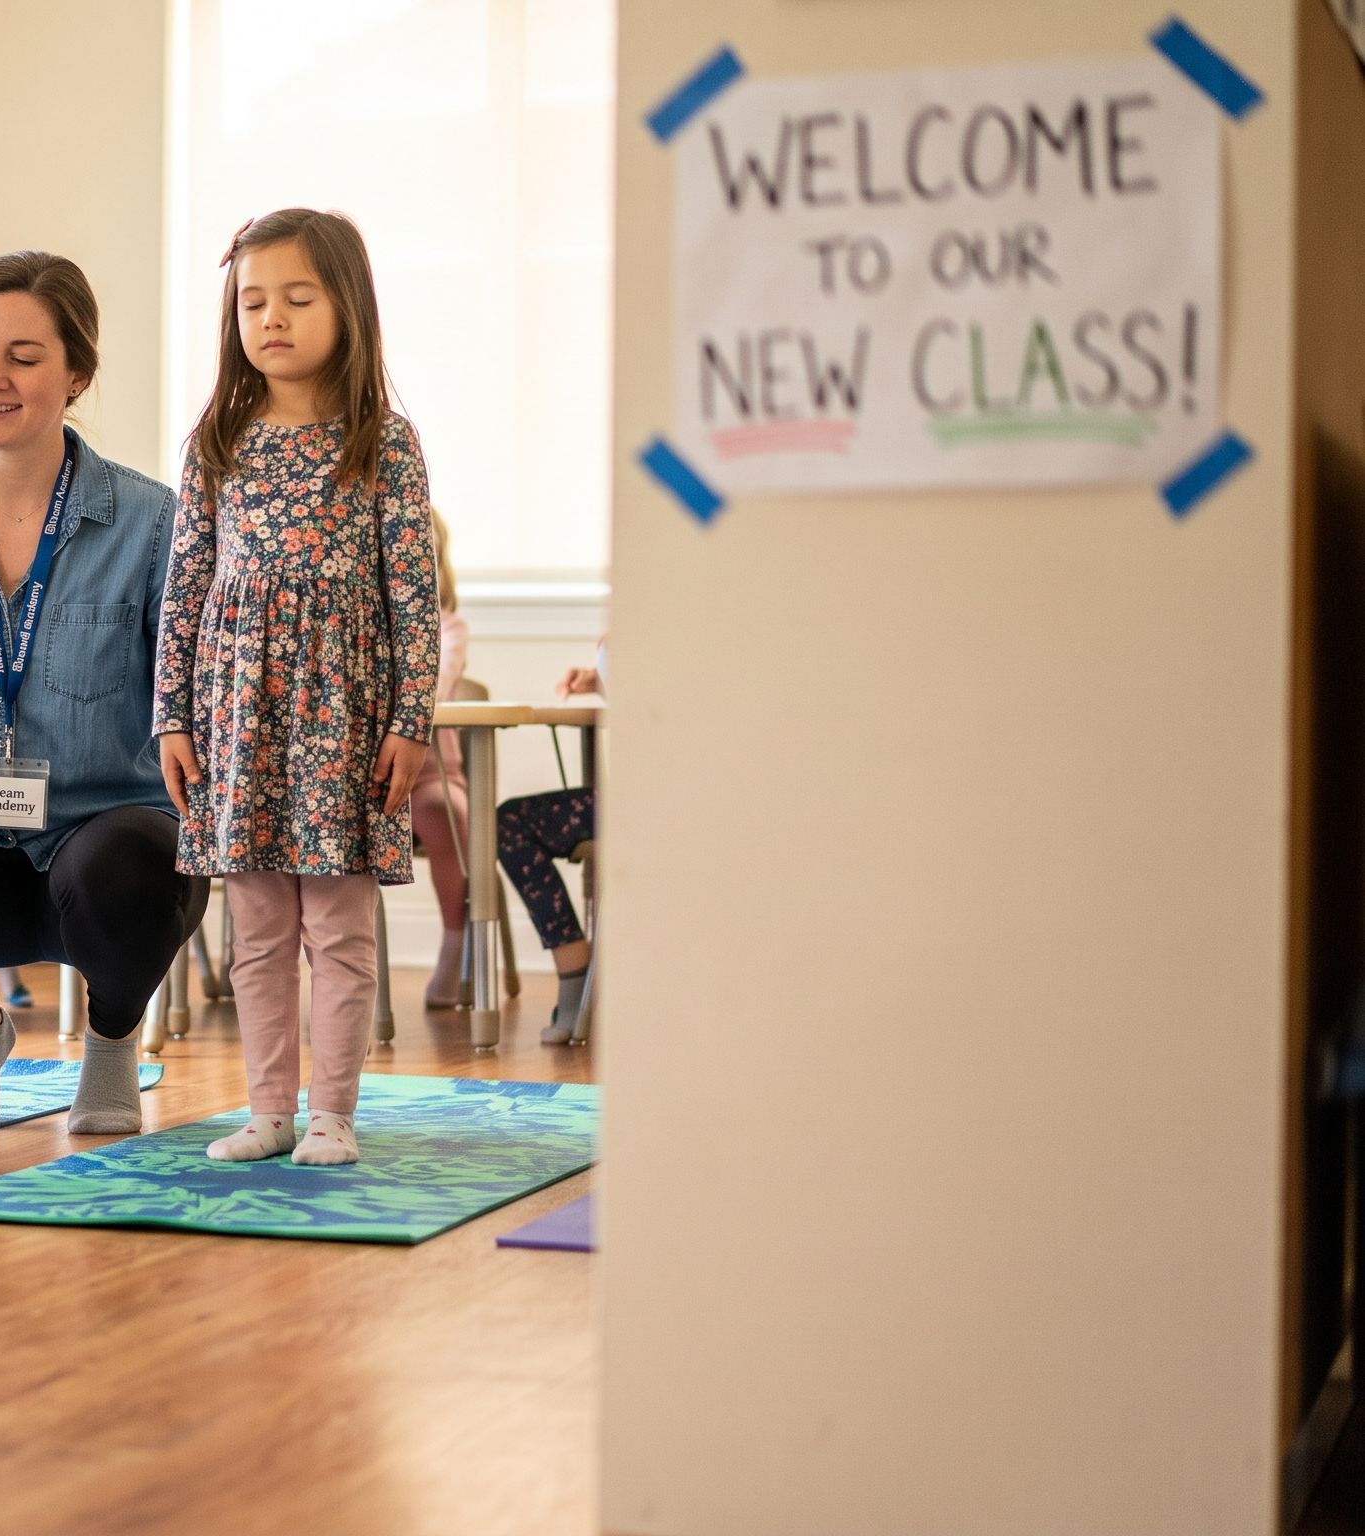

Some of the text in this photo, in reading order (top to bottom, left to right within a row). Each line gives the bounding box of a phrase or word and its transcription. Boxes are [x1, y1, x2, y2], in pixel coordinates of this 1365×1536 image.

[708, 92, 1158, 213] WELCOME
[805, 222, 1059, 297] TO OUR
[699, 300, 1199, 426] NEW CLASS!
